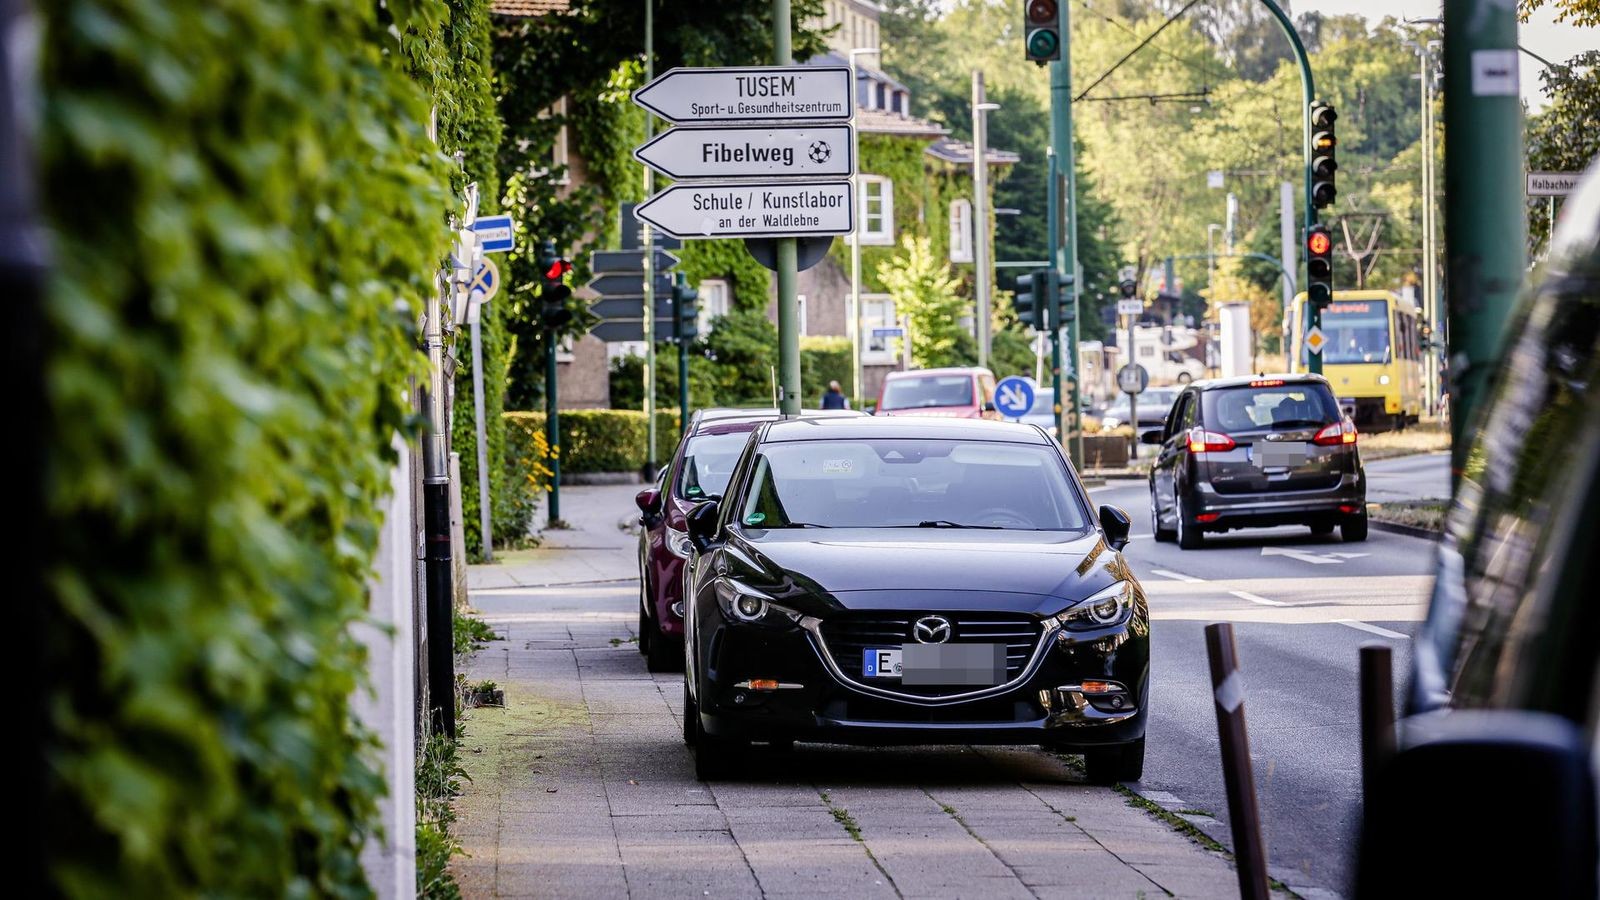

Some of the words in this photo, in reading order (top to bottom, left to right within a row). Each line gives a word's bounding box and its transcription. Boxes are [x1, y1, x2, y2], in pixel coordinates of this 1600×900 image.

[735, 76, 795, 97] TUSEM
[702, 143, 794, 166] Fibelweg
[693, 192, 743, 211] Schule
[719, 217, 732, 228] an
[738, 215, 756, 228] der
[878, 652, 892, 673] E
